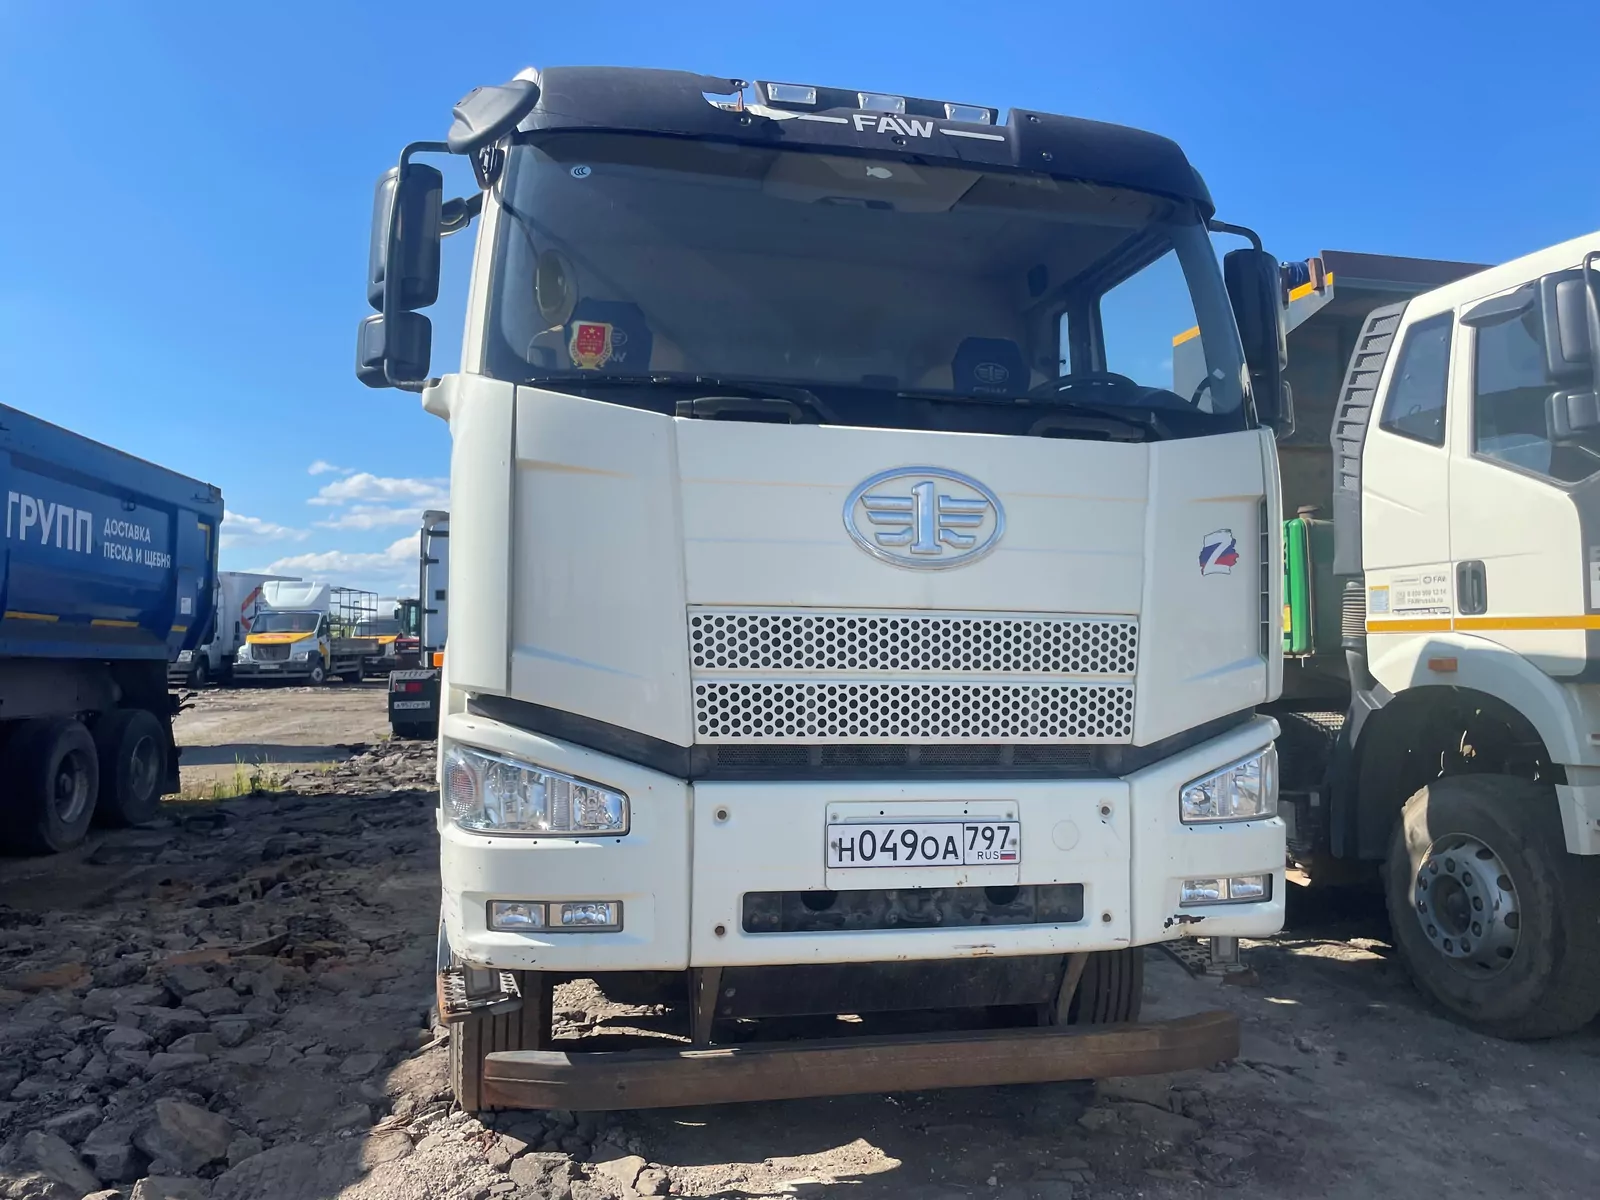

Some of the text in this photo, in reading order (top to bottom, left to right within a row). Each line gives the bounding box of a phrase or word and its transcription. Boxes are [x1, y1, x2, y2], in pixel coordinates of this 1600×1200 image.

[852, 114, 934, 138] FAW
[6, 491, 92, 554] ГРУПП
[104, 518, 151, 543] ДОСТАВКА
[104, 541, 171, 569] ПЕСКА И ЩЕБНЯ
[965, 826, 1010, 850] 797
[977, 851, 999, 860] RUS
